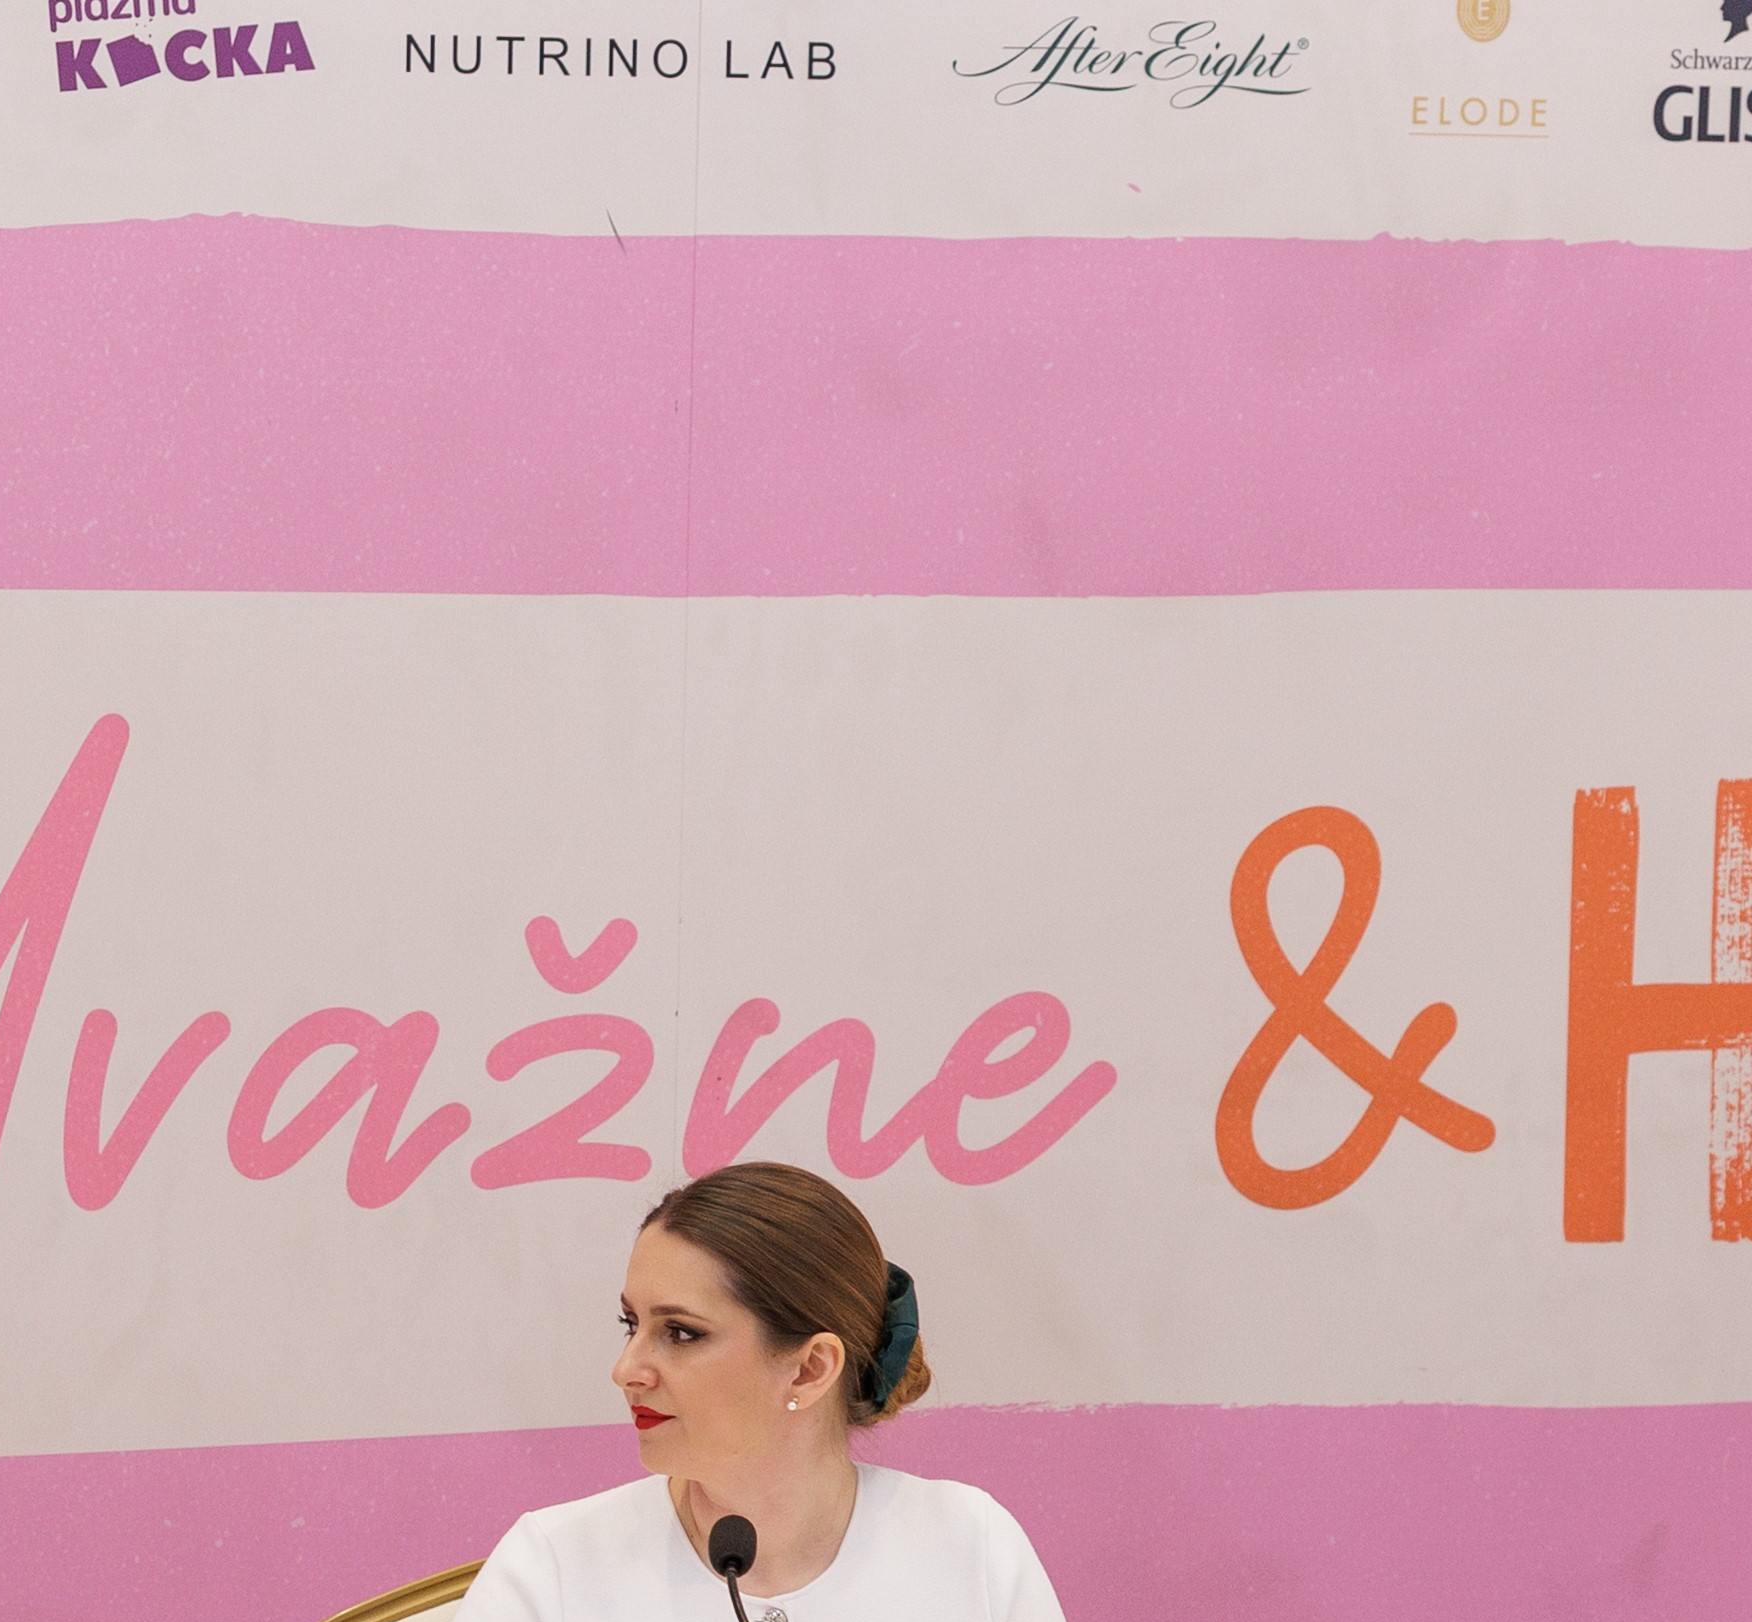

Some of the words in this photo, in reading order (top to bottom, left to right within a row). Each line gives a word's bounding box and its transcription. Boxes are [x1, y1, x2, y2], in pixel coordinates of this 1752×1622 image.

[405, 34, 689, 79] NUTRINO
[725, 40, 836, 80] LAB
[953, 16, 1143, 106] After
[1411, 96, 1547, 128] ELODE
[1215, 805, 1496, 1211] &
